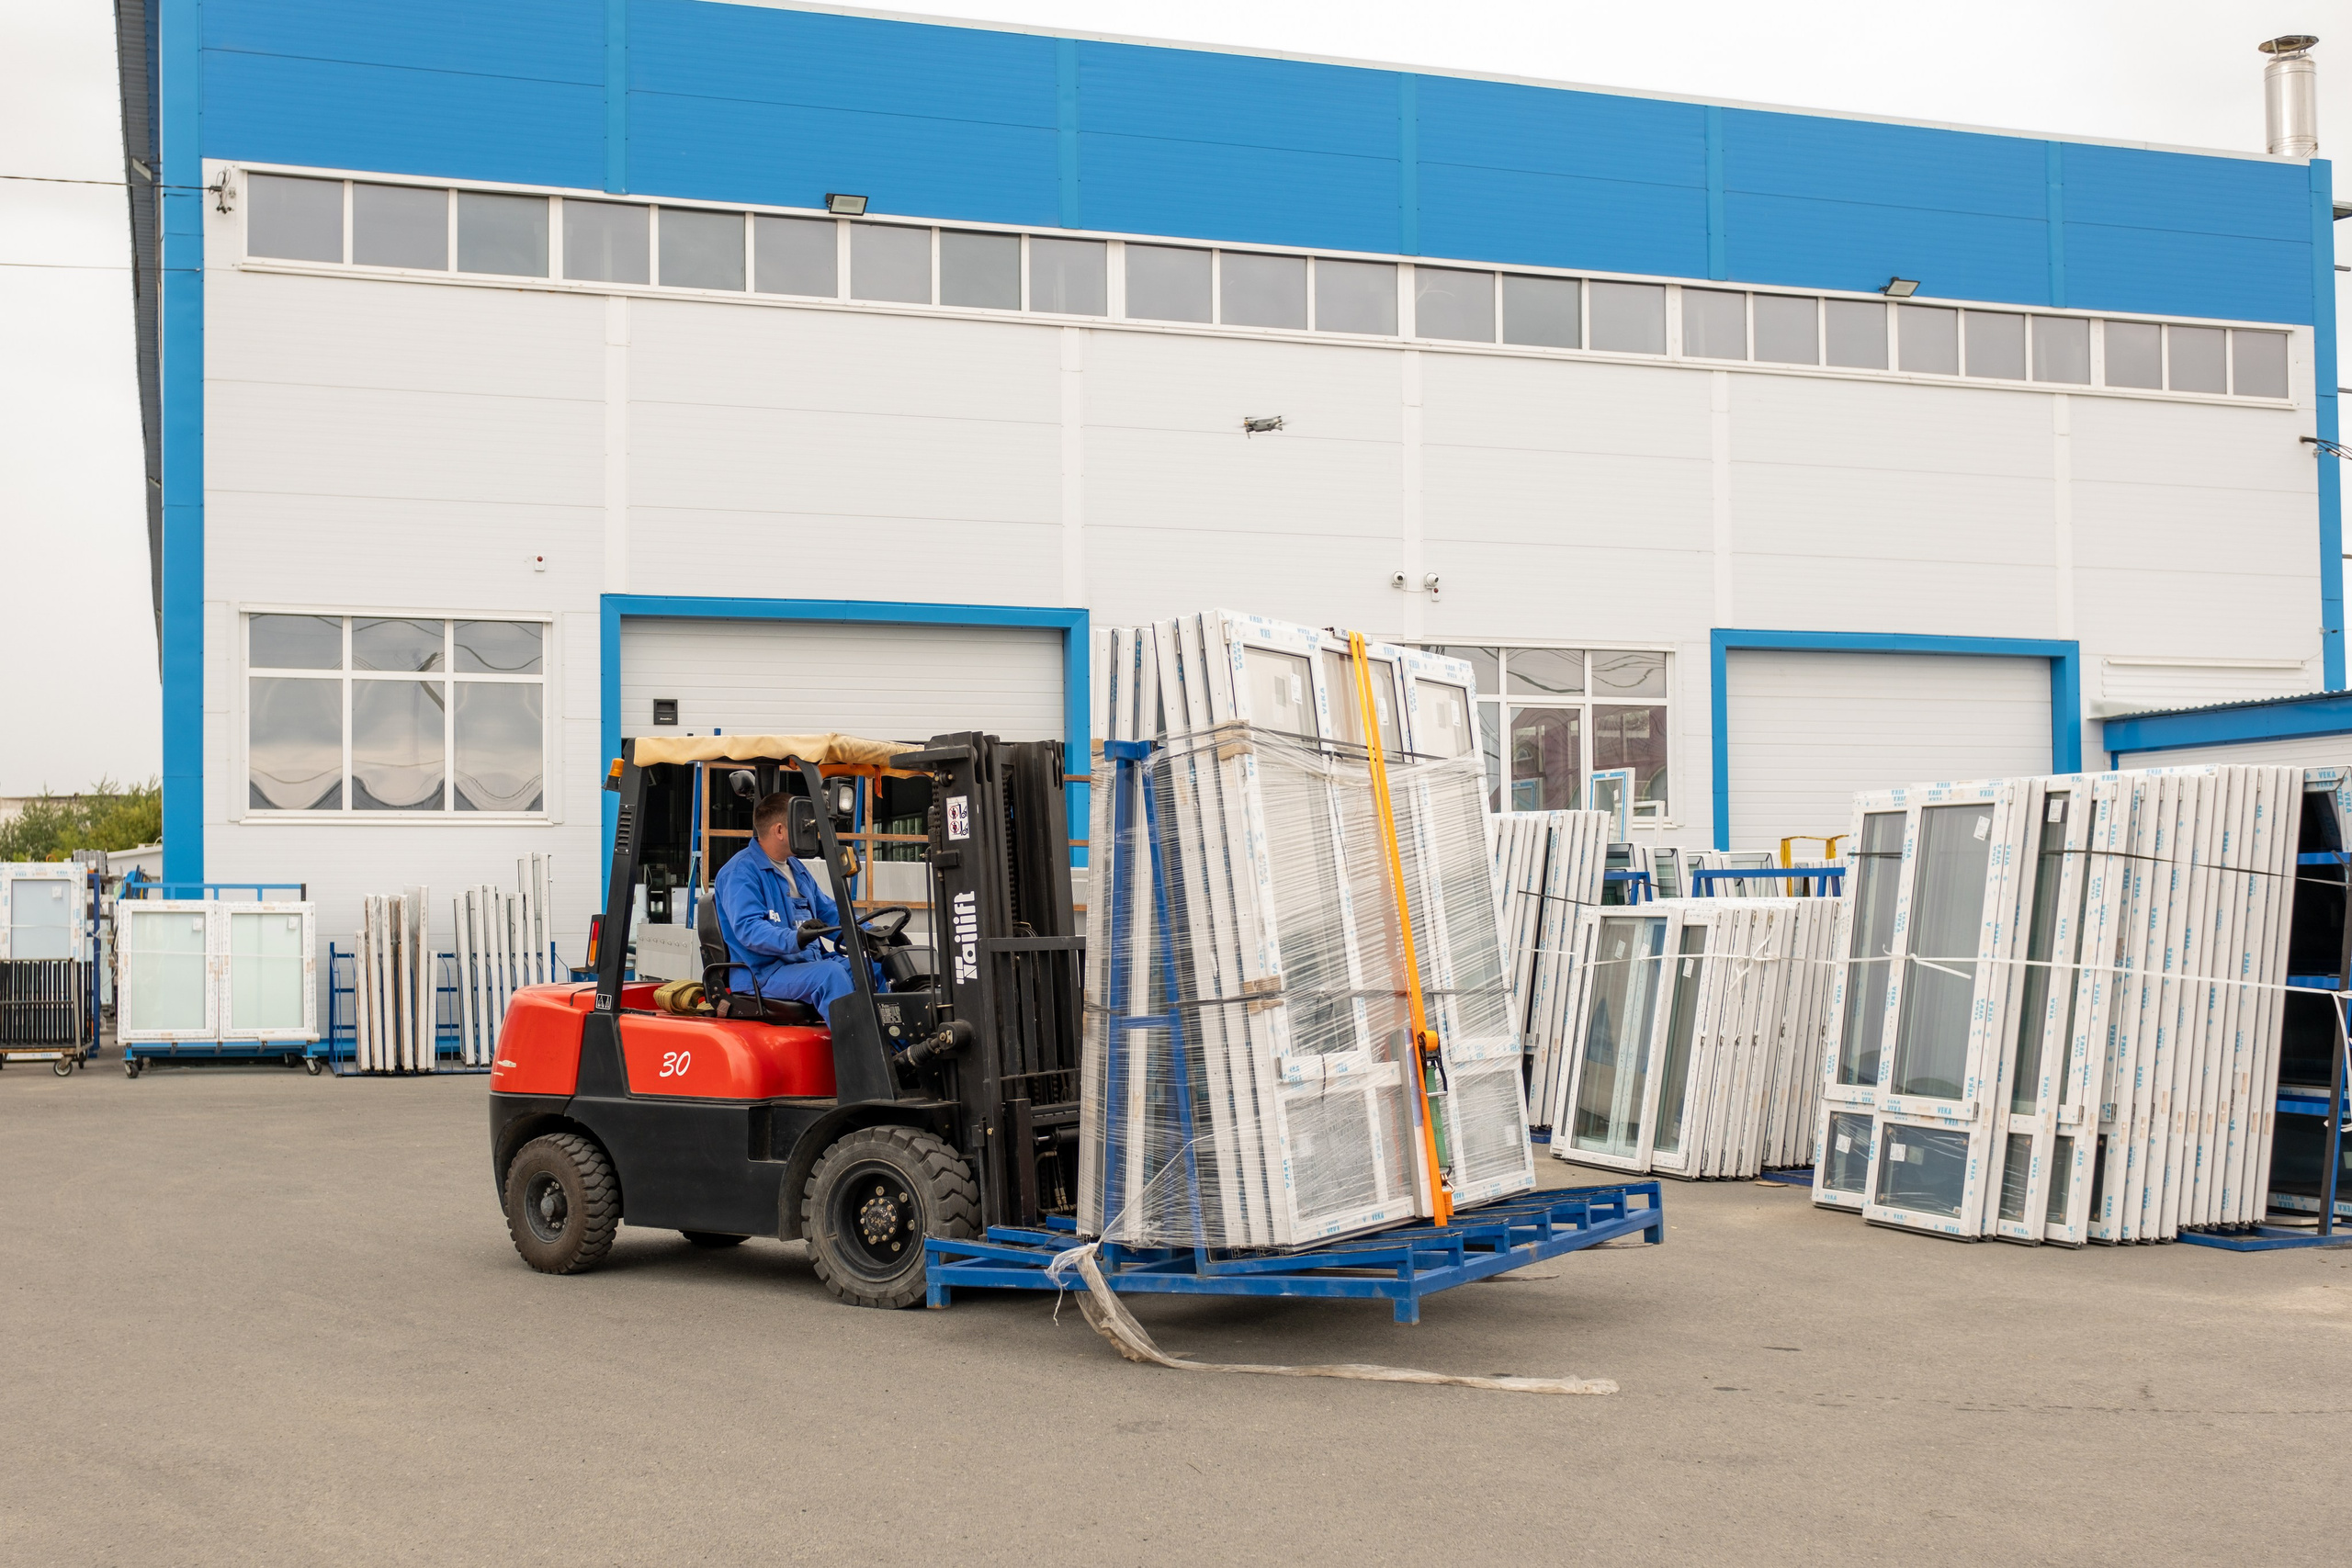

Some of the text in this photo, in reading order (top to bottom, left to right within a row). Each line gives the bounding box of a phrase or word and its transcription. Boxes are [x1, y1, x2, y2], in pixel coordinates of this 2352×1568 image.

[2318, 771, 2336, 780] VEKA
[2099, 799, 2108, 820] VEKA
[2344, 792, 2352, 814] VEKA
[954, 890, 978, 985] Tailift
[2109, 1024, 2117, 1046] VEKA
[659, 1051, 691, 1077] 30
[1937, 1106, 1952, 1115] VEKA
[1969, 1158, 1977, 1180] VEKA
[1945, 1224, 1960, 1234] VEKA
[2014, 1227, 2029, 1235] VEKA
